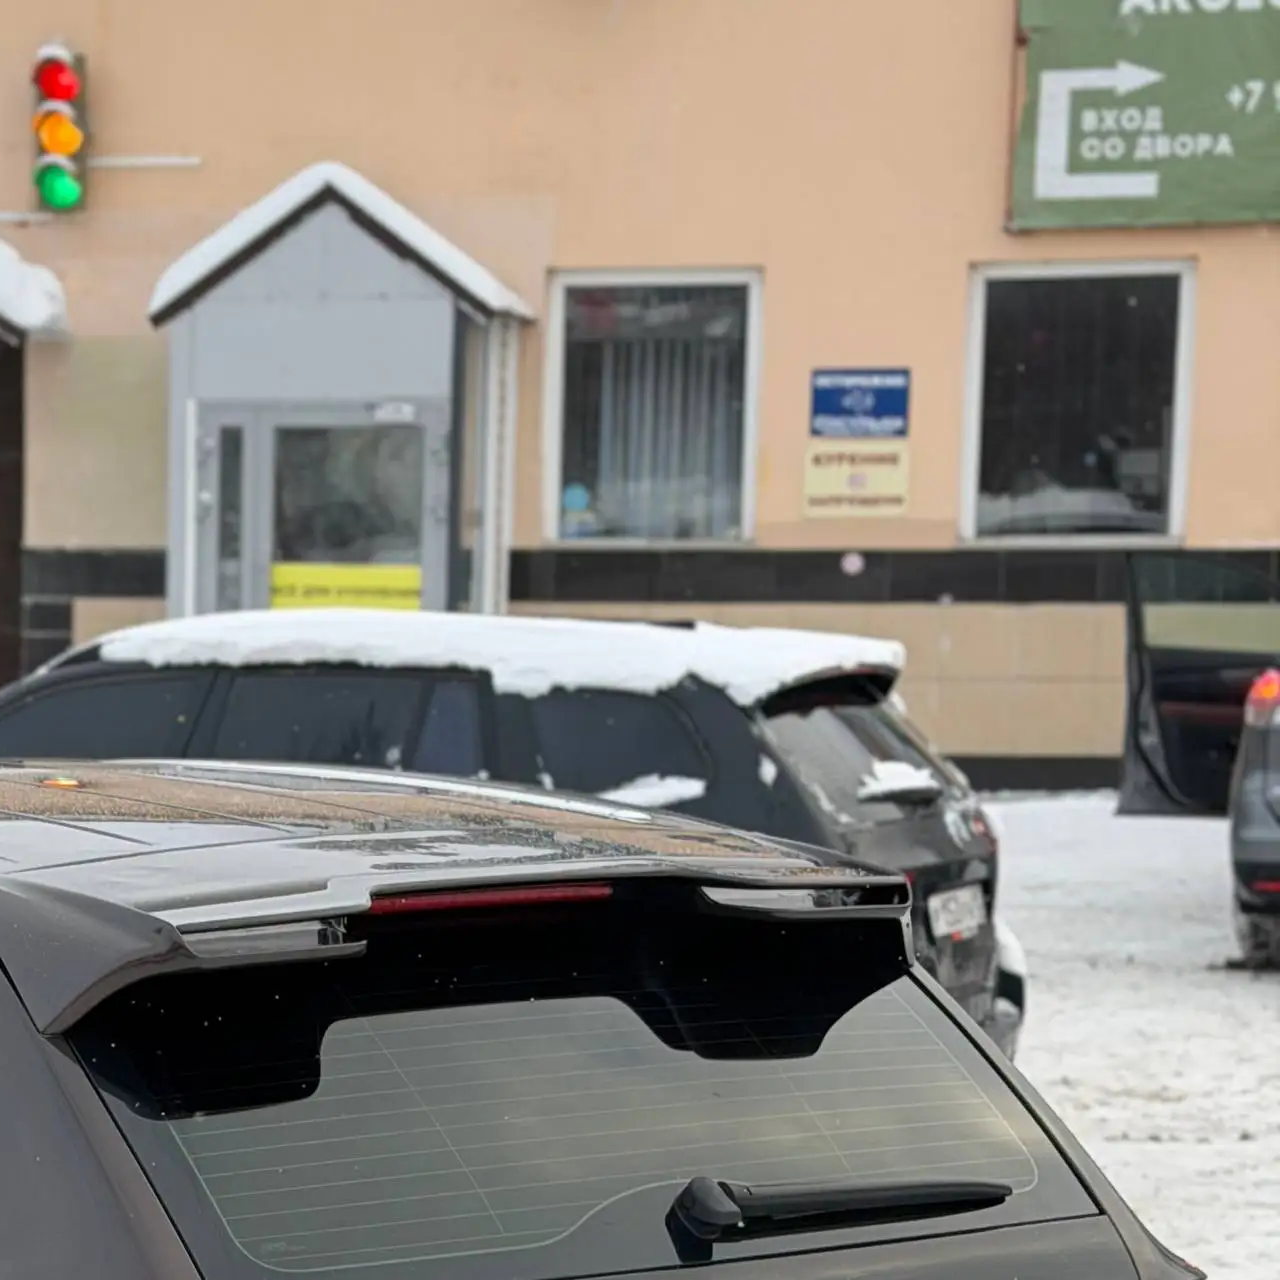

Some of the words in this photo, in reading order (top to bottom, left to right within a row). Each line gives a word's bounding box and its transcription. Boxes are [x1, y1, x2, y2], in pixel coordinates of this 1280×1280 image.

[1081, 106, 1163, 132] ВХОД
[1079, 136, 1126, 161] СО
[1133, 133, 1234, 161] ДВОРА
